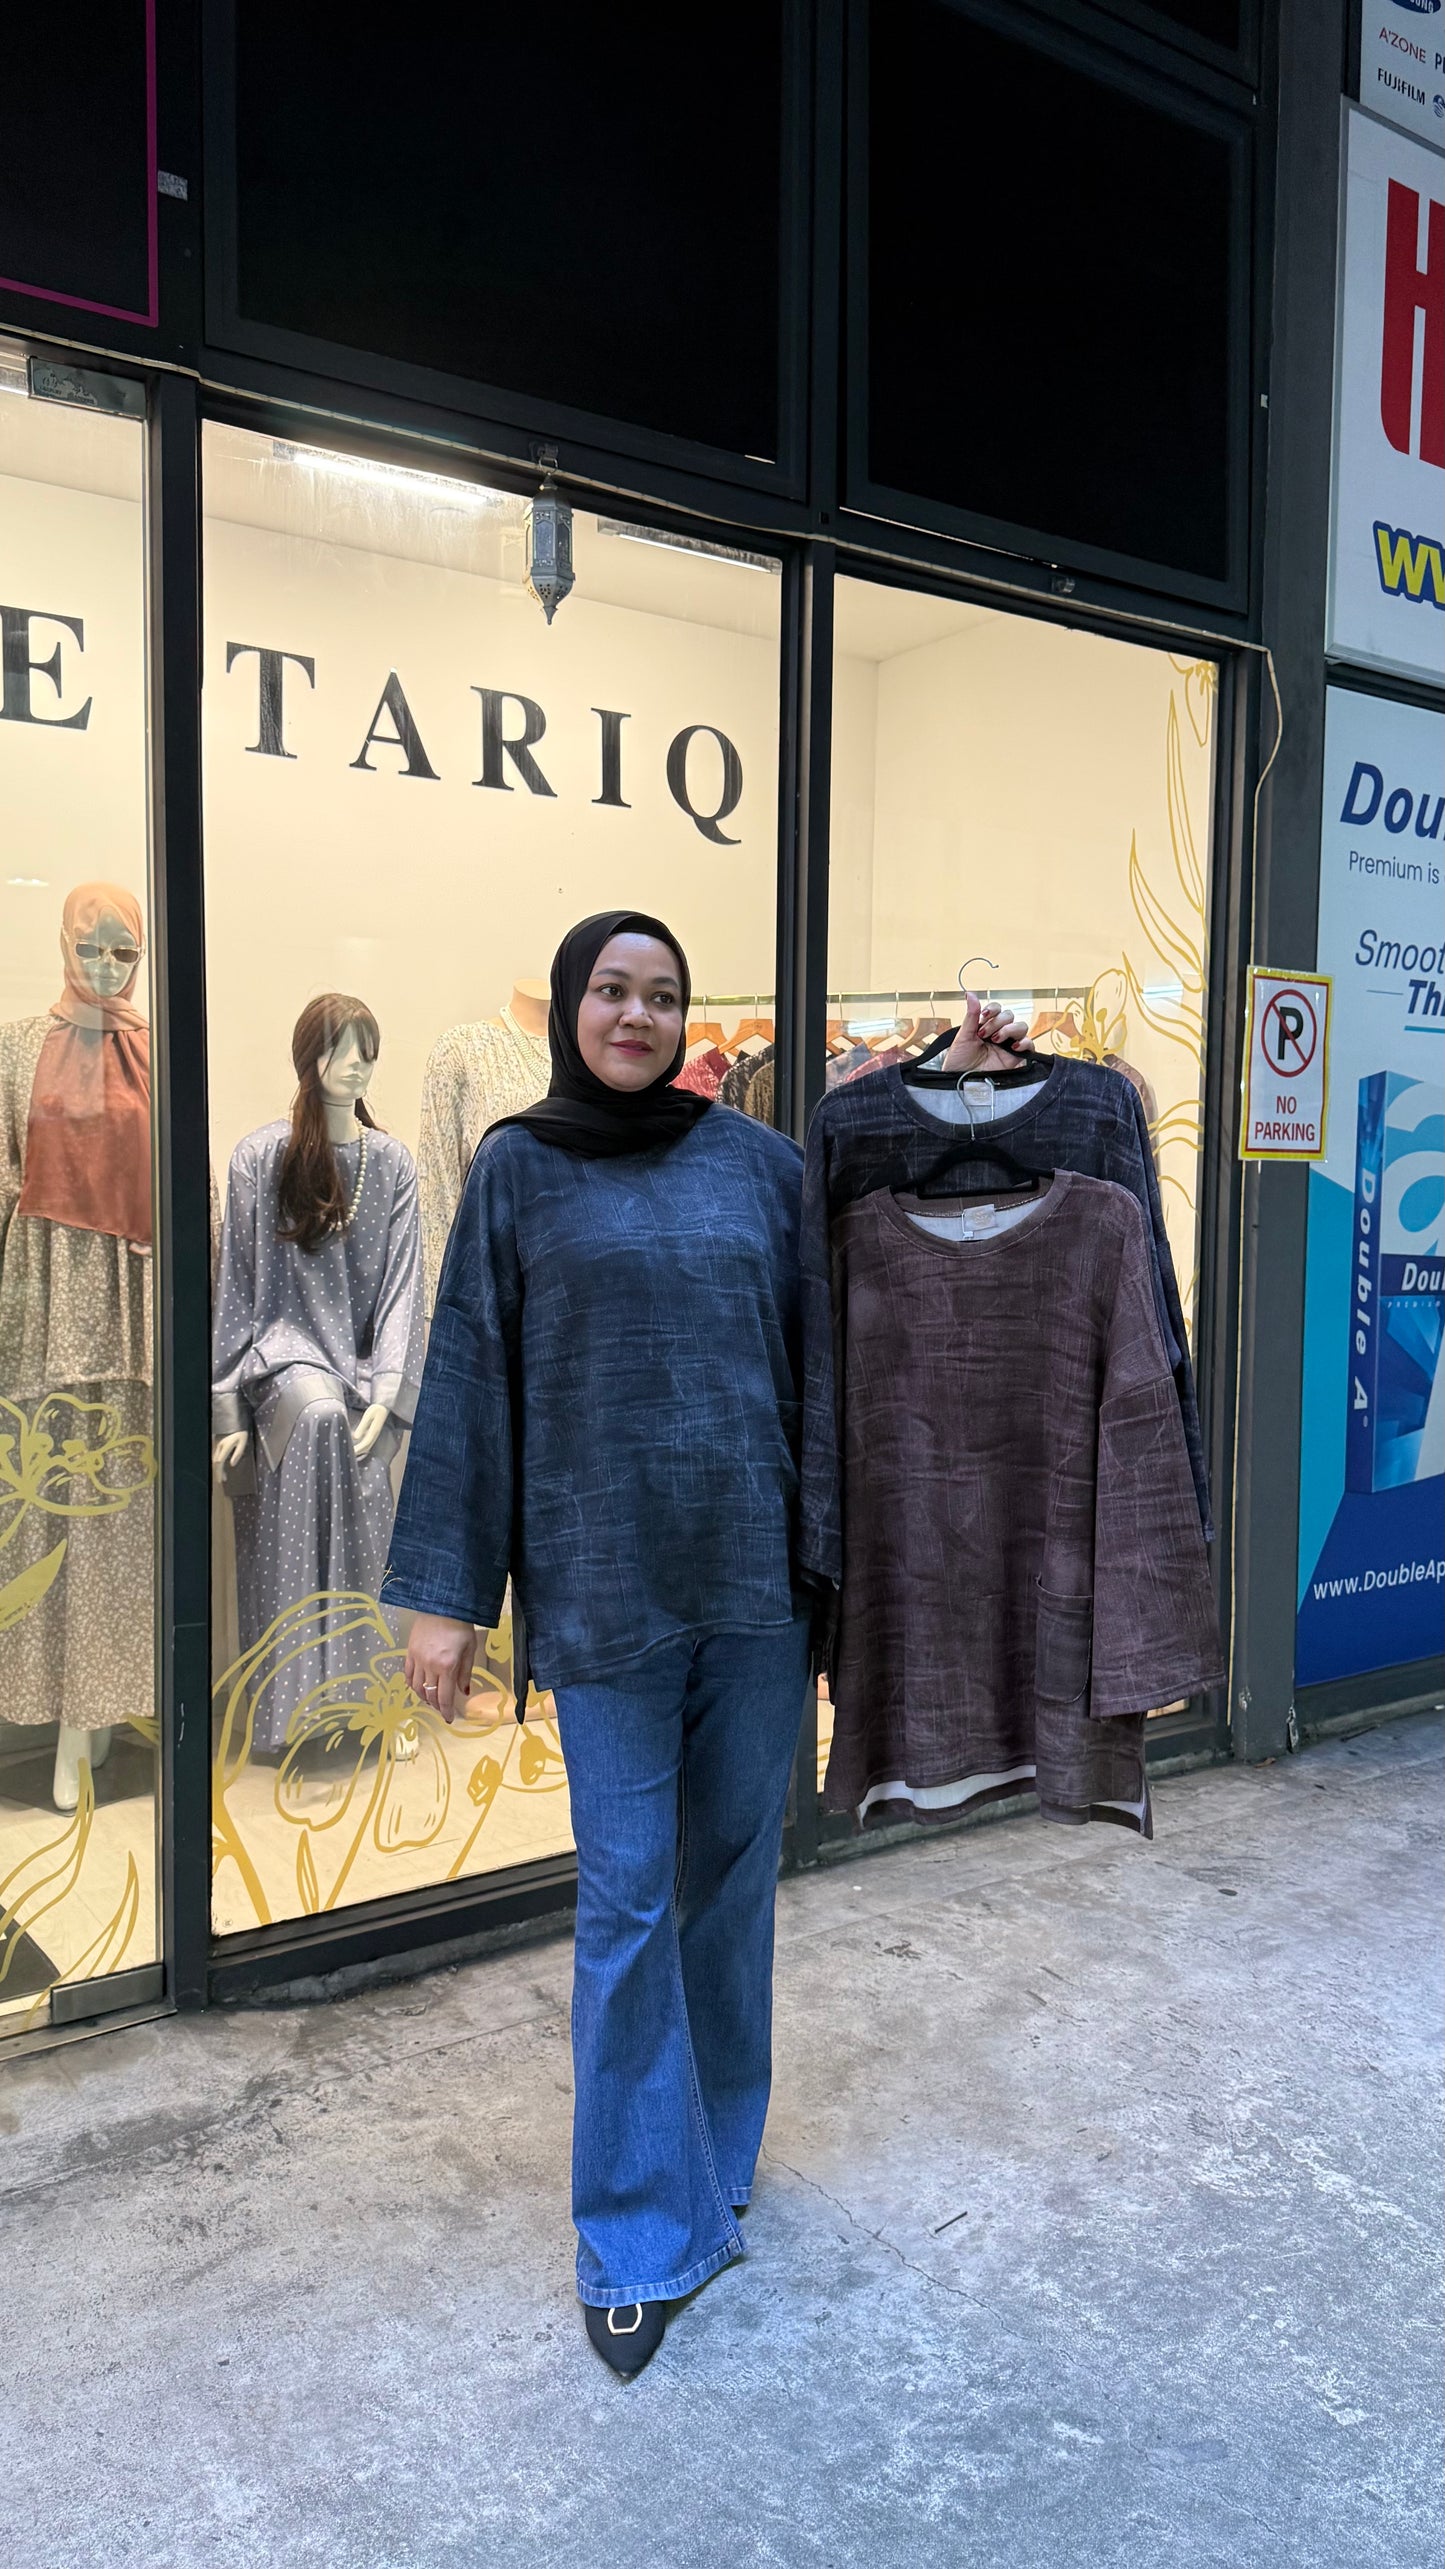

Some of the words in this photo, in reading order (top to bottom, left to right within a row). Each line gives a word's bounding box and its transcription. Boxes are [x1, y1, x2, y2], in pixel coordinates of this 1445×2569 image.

[1379, 27, 1427, 64] A'ZONE
[1377, 67, 1425, 105] FUJIFILM
[226, 640, 744, 846] TARIQ
[1340, 761, 1445, 841] Dou
[1349, 850, 1423, 882] Premium
[1428, 862, 1440, 885] is
[1276, 1096, 1297, 1115] NO
[1254, 1121, 1315, 1142] PARKING
[1355, 1167, 1376, 1356] Double
[1401, 1262, 1445, 1291] Dou
[1353, 1376, 1369, 1411] A
